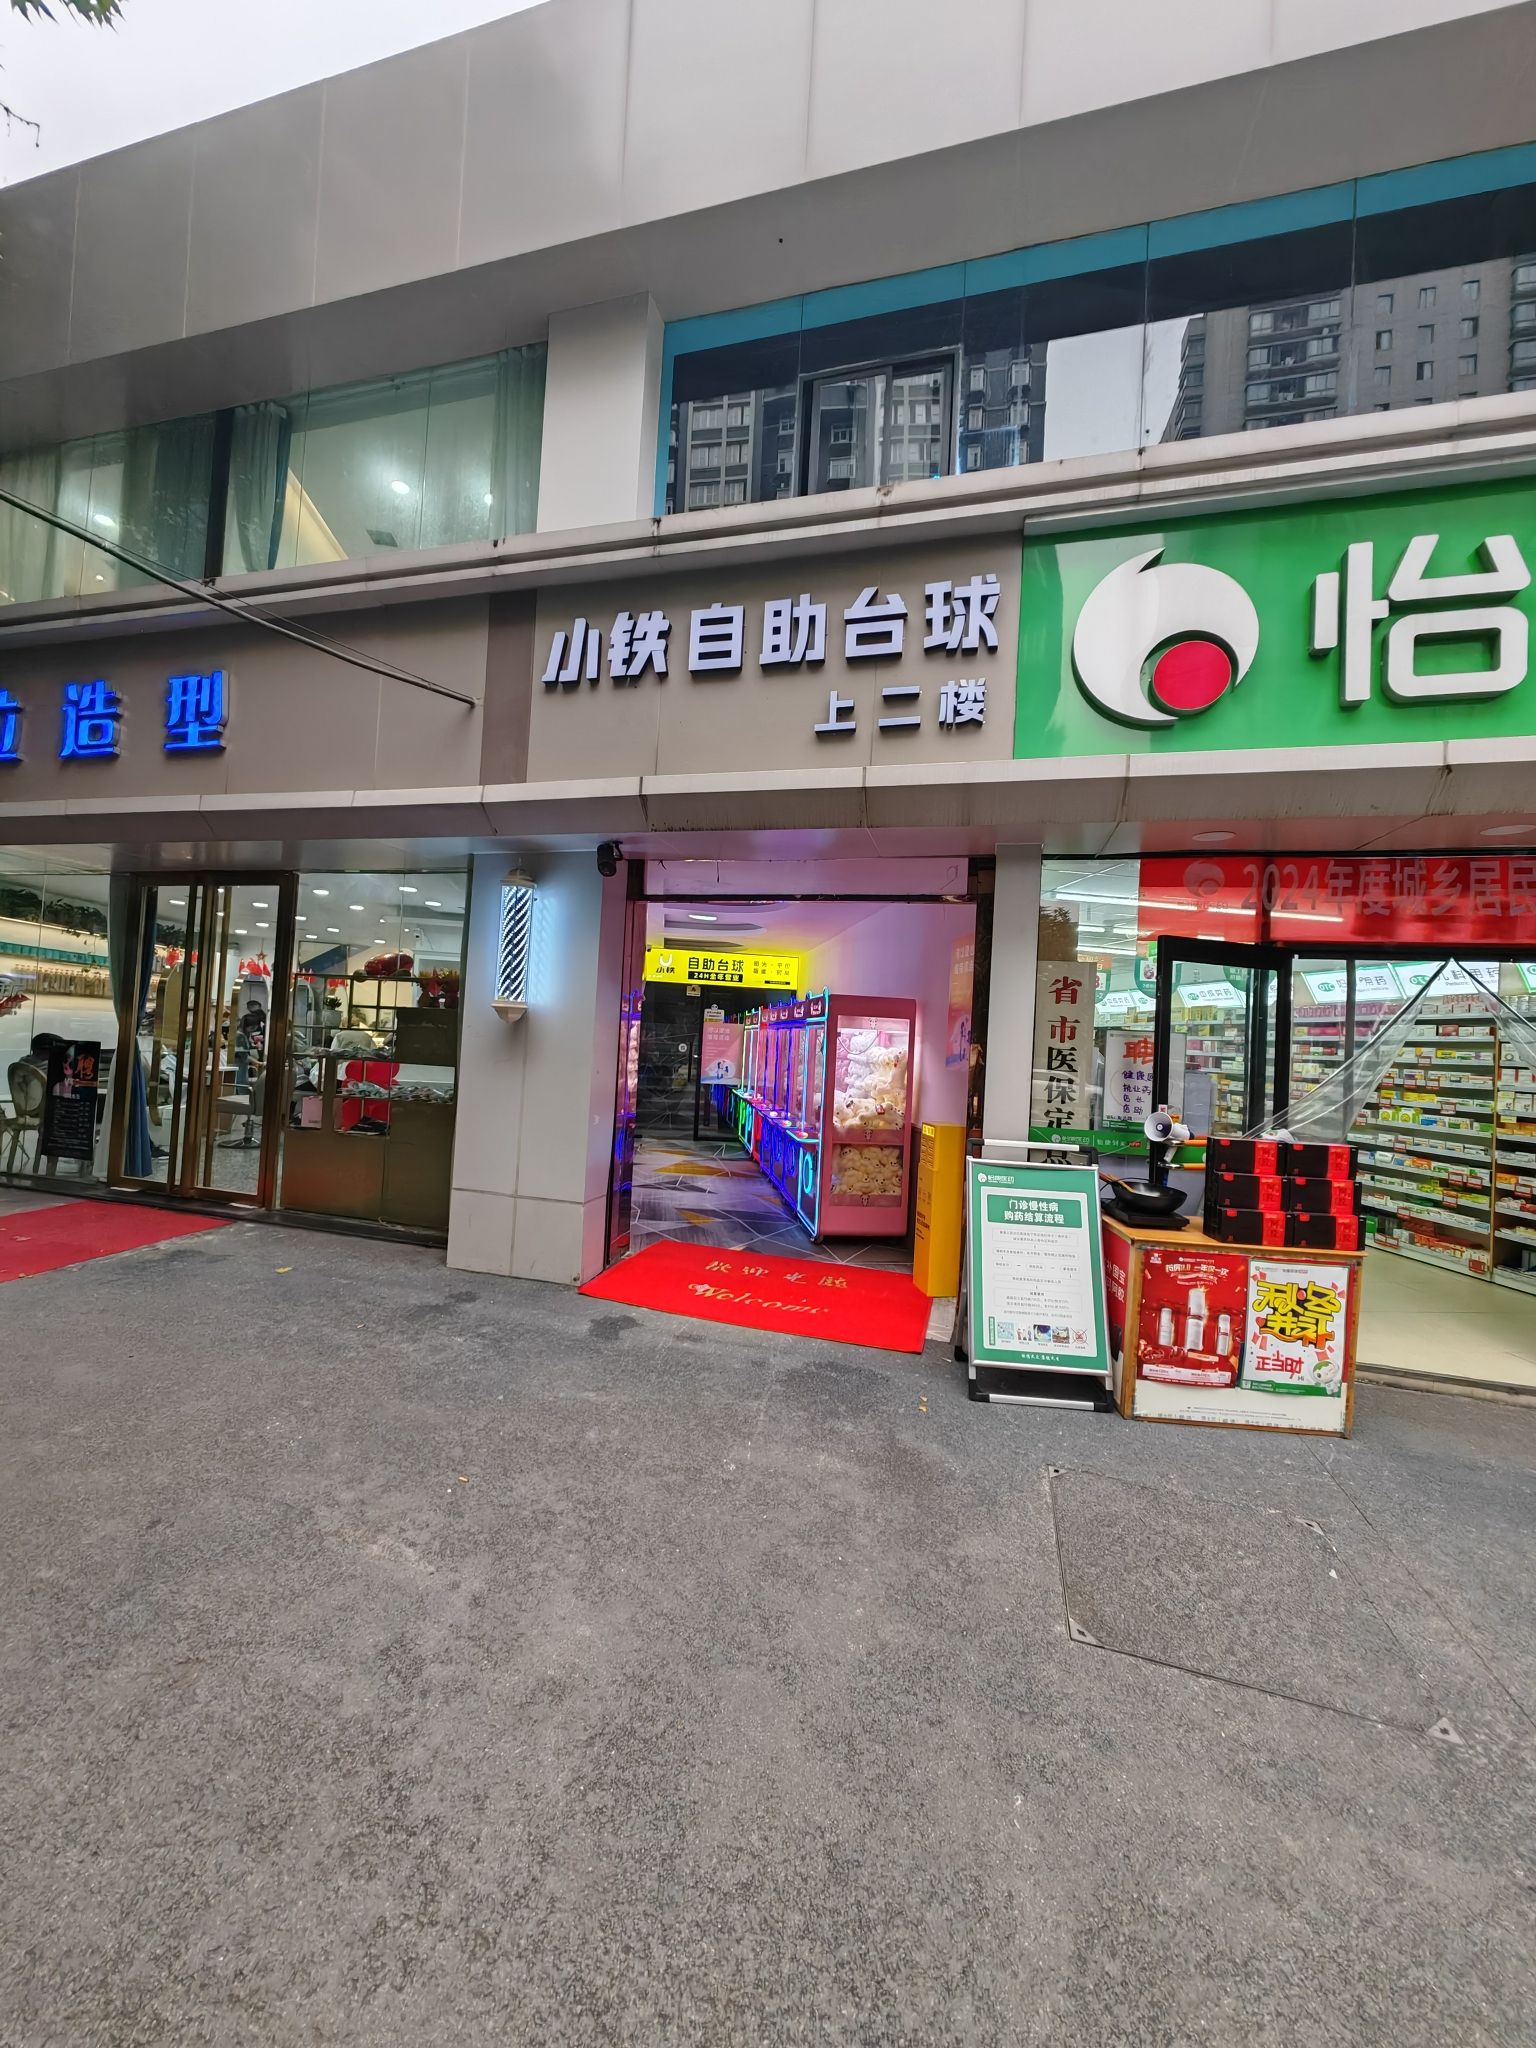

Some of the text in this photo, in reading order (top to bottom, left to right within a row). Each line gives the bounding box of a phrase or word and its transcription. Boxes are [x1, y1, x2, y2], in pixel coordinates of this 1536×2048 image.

[541, 573, 1003, 686] 小铁自助台球
[1309, 533, 1532, 707] 怡
[813, 677, 988, 735] 上二楼
[688, 956, 744, 973] 自助台球
[1003, 1210, 1065, 1225] 购药结算流程
[1008, 1199, 1059, 1213] 门诊慢性病
[1254, 1350, 1305, 1380] 正当时
